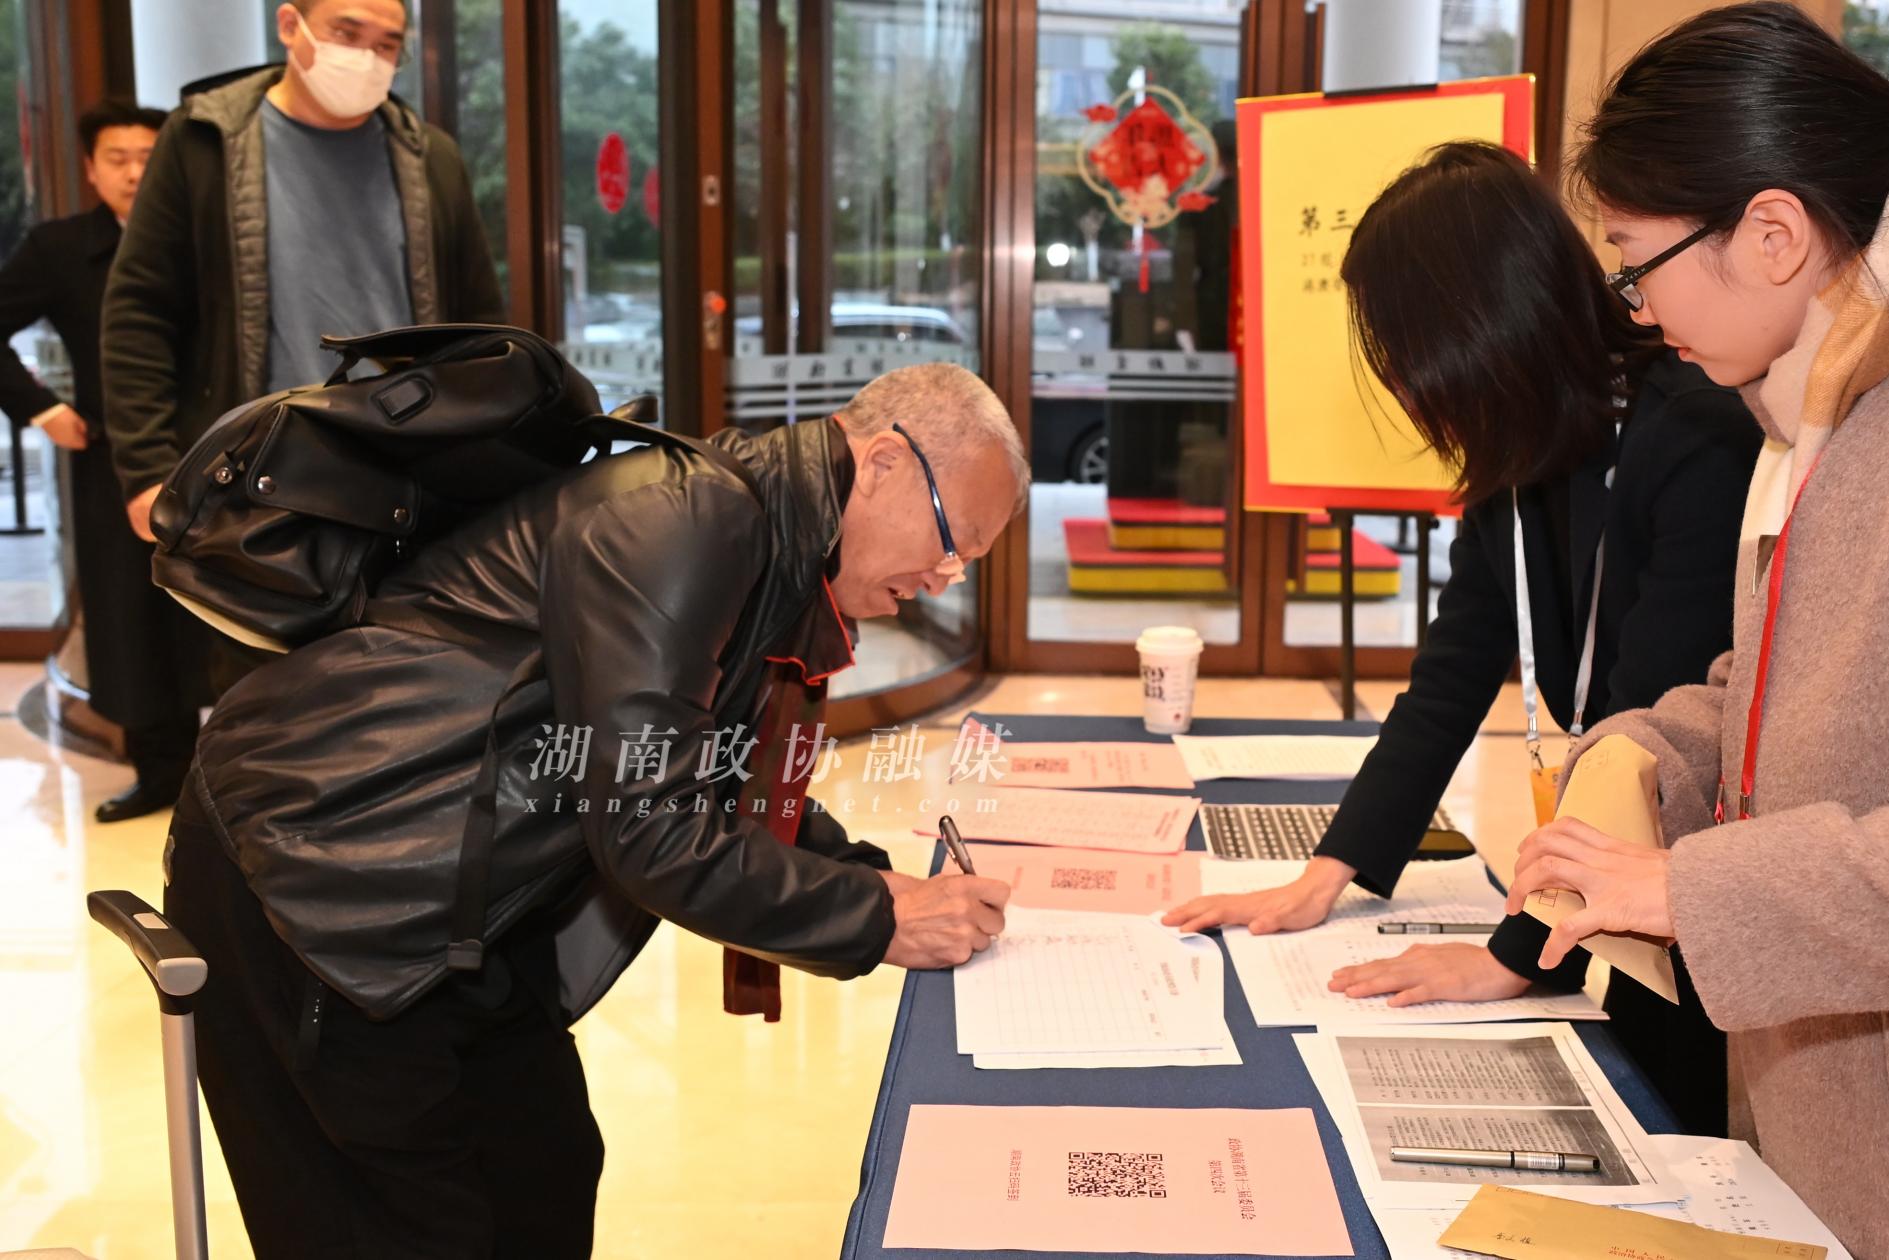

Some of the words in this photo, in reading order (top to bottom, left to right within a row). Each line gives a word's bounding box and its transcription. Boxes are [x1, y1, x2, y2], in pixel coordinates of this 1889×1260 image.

[1208, 1160, 1226, 1194] 第四次会议
[1228, 1137, 1257, 1220] 政协湖南省第十三届委员会
